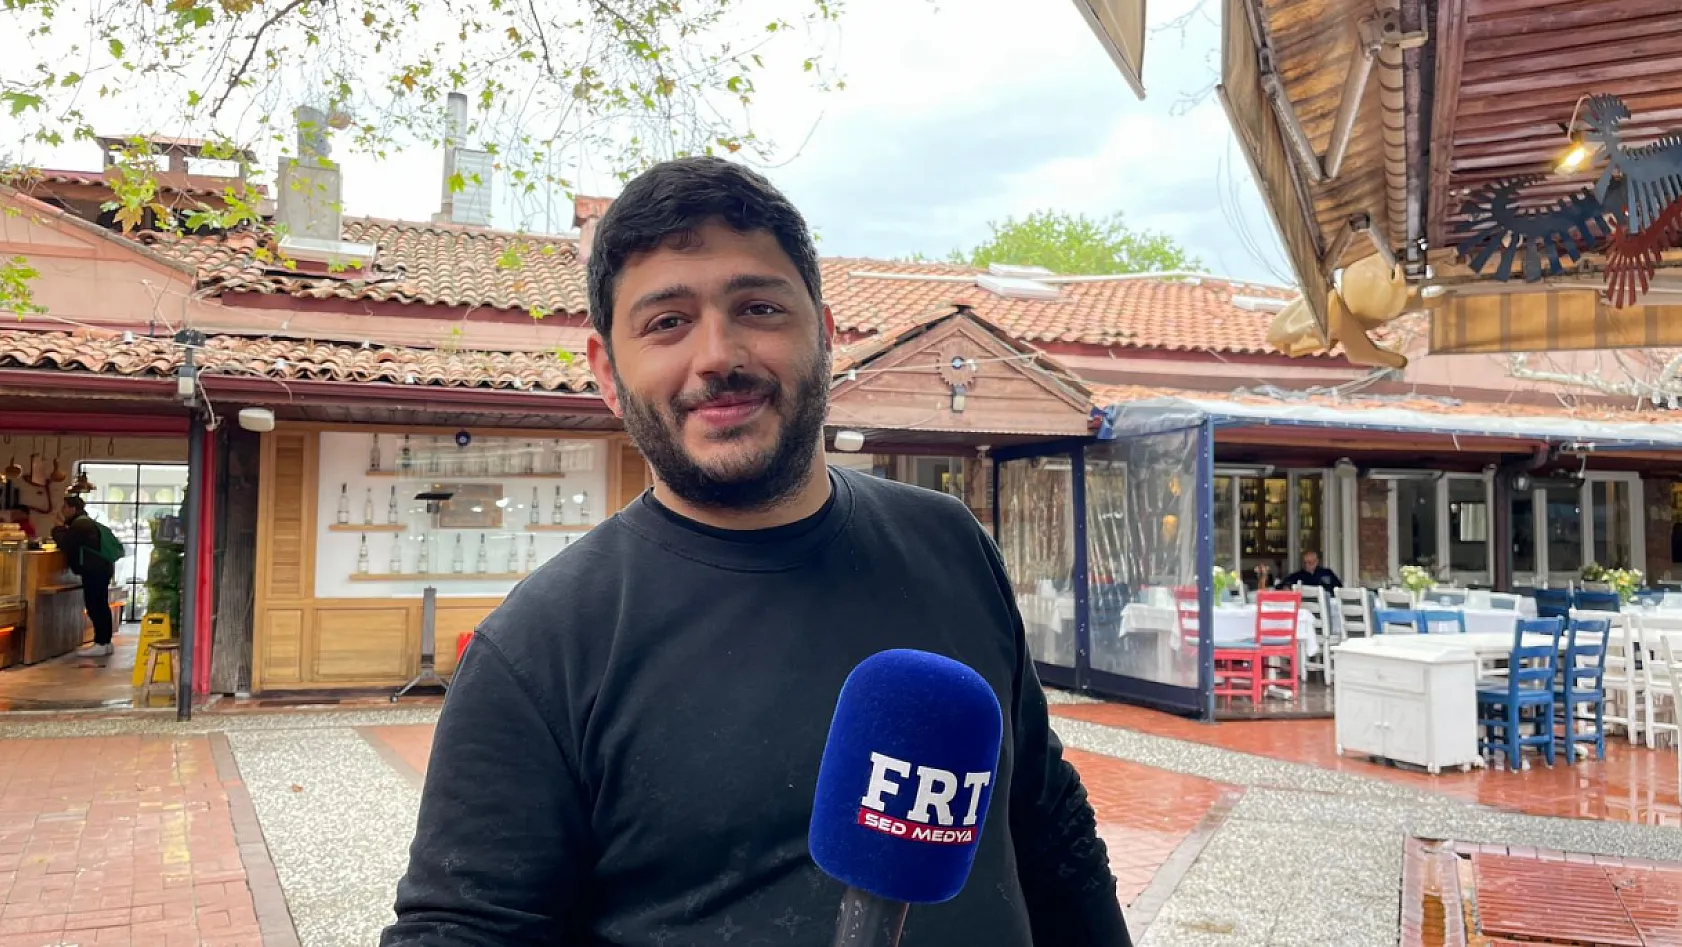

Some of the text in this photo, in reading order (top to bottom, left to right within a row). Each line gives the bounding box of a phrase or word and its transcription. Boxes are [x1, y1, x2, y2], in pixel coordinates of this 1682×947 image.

[860, 751, 991, 826] FRT
[864, 812, 973, 843] SED MEDYA
